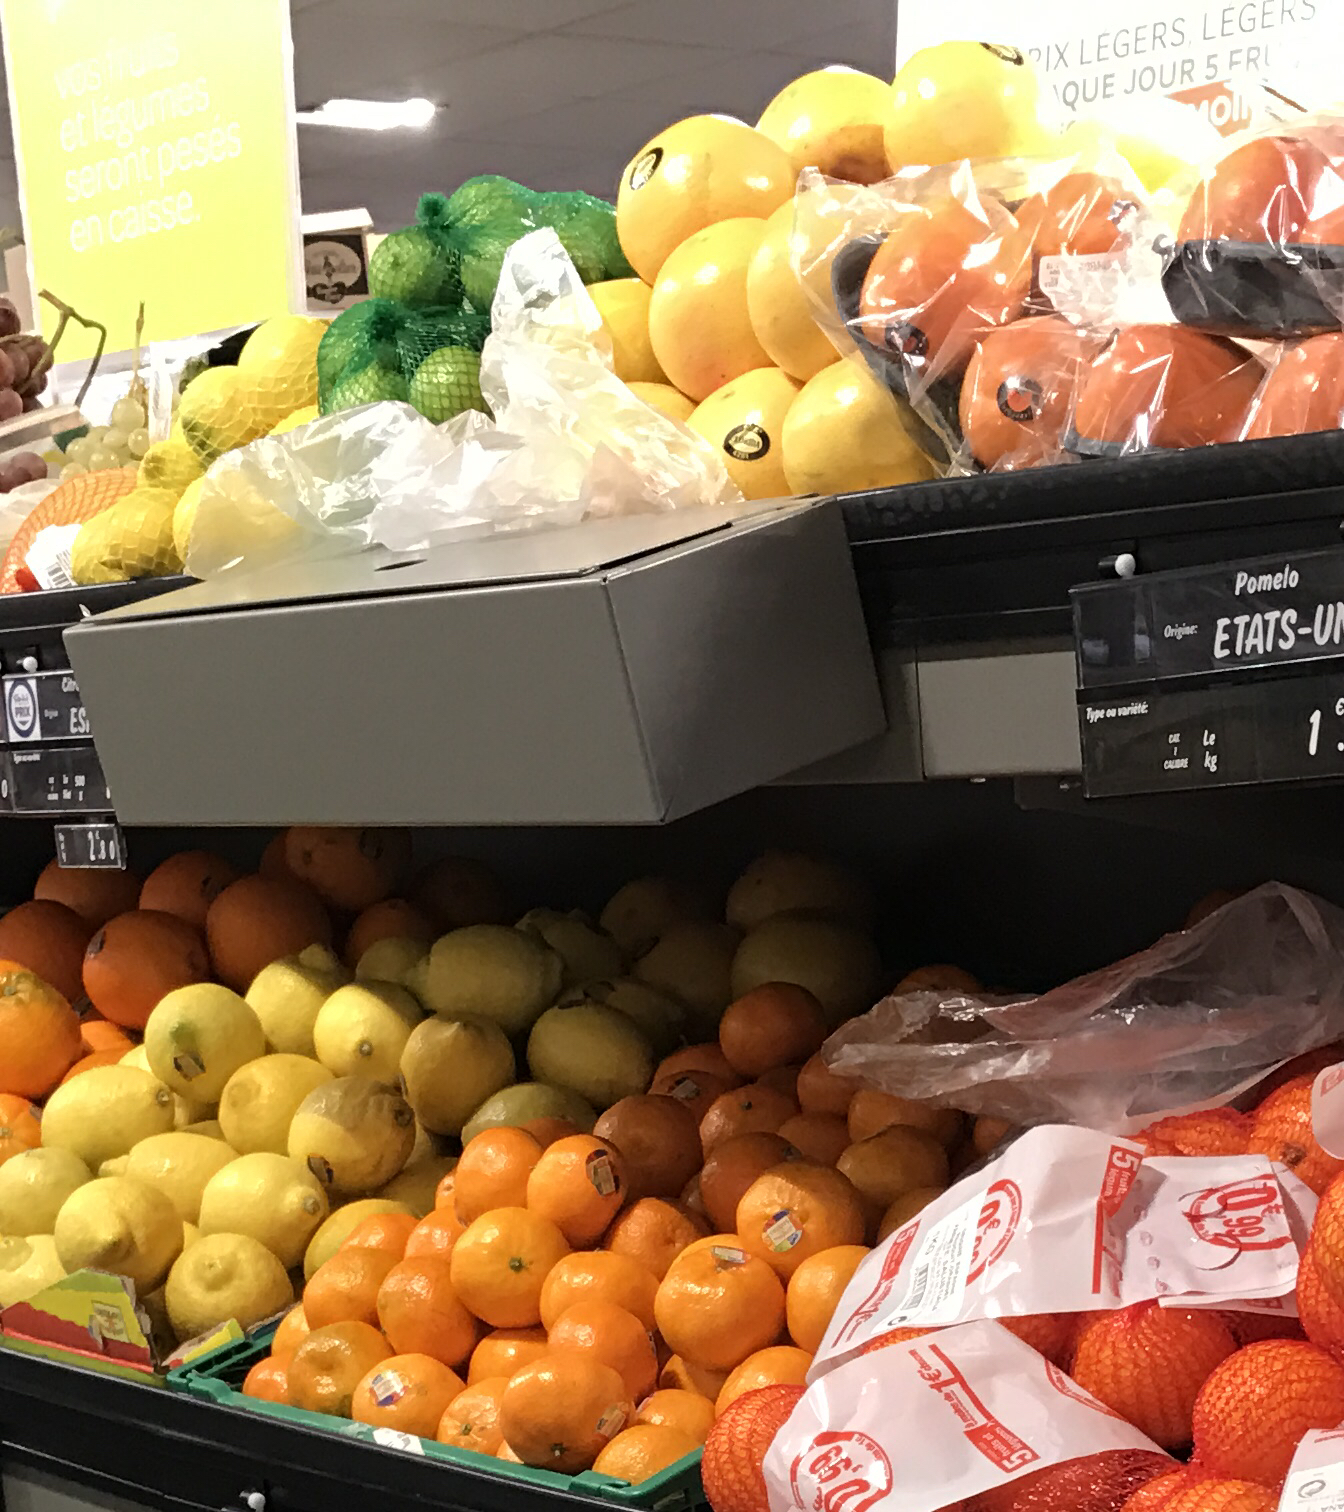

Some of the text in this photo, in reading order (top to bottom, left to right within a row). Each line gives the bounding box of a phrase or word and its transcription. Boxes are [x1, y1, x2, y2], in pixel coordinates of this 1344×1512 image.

[1124, 57, 1195, 95] JOUR
[1205, 52, 1219, 80] 5
[60, 77, 211, 152] et légumes
[65, 113, 243, 203] seront pesés
[69, 190, 202, 253] en caisse.
[1235, 564, 1300, 596] Pomelo
[1086, 702, 1150, 723] Type ou variété:
[1203, 729, 1216, 747] Le
[1203, 751, 1218, 773] kg
[1112, 1150, 1138, 1172] 5
[1002, 1449, 1033, 1471] 5
